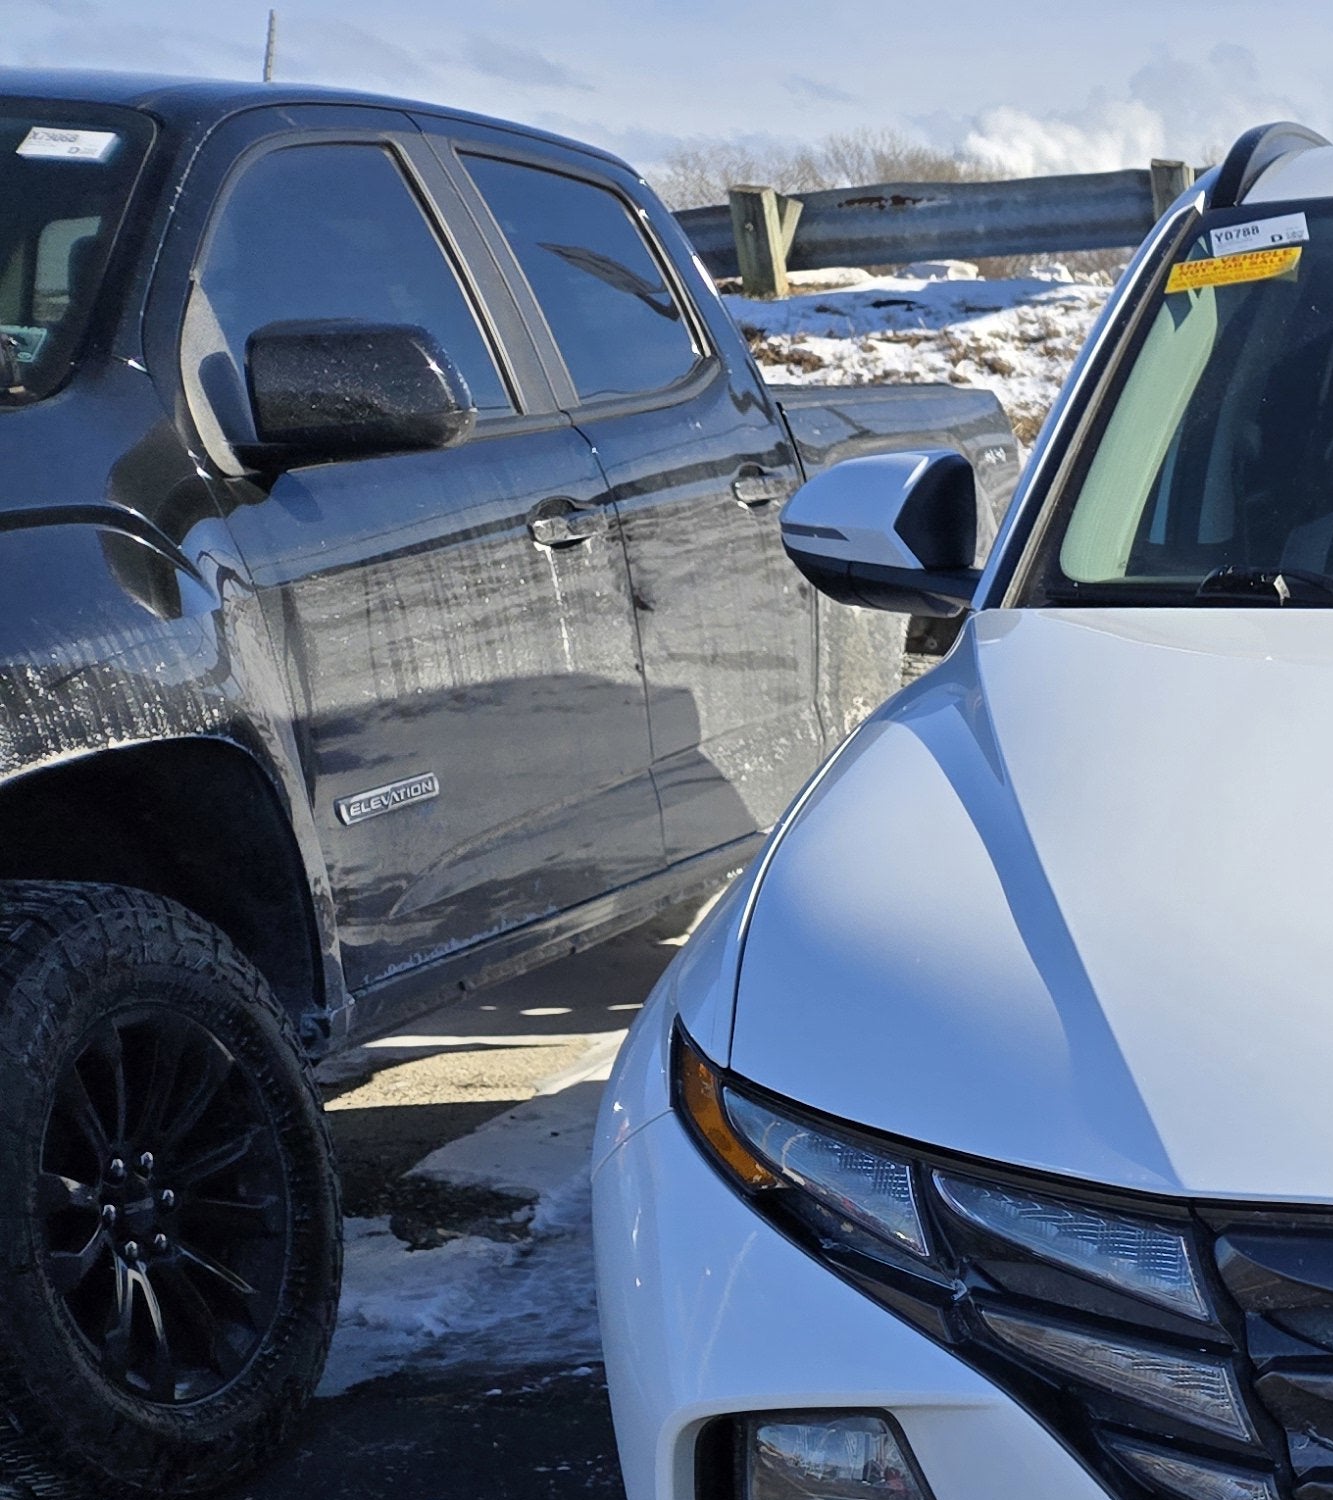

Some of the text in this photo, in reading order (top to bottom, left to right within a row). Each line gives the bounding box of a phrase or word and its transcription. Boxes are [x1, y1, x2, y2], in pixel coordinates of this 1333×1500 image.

[1270, 234, 1283, 242] D
[1213, 261, 1243, 272] FOR
[1249, 256, 1286, 267] SALE
[350, 780, 433, 816] ELEVATION
